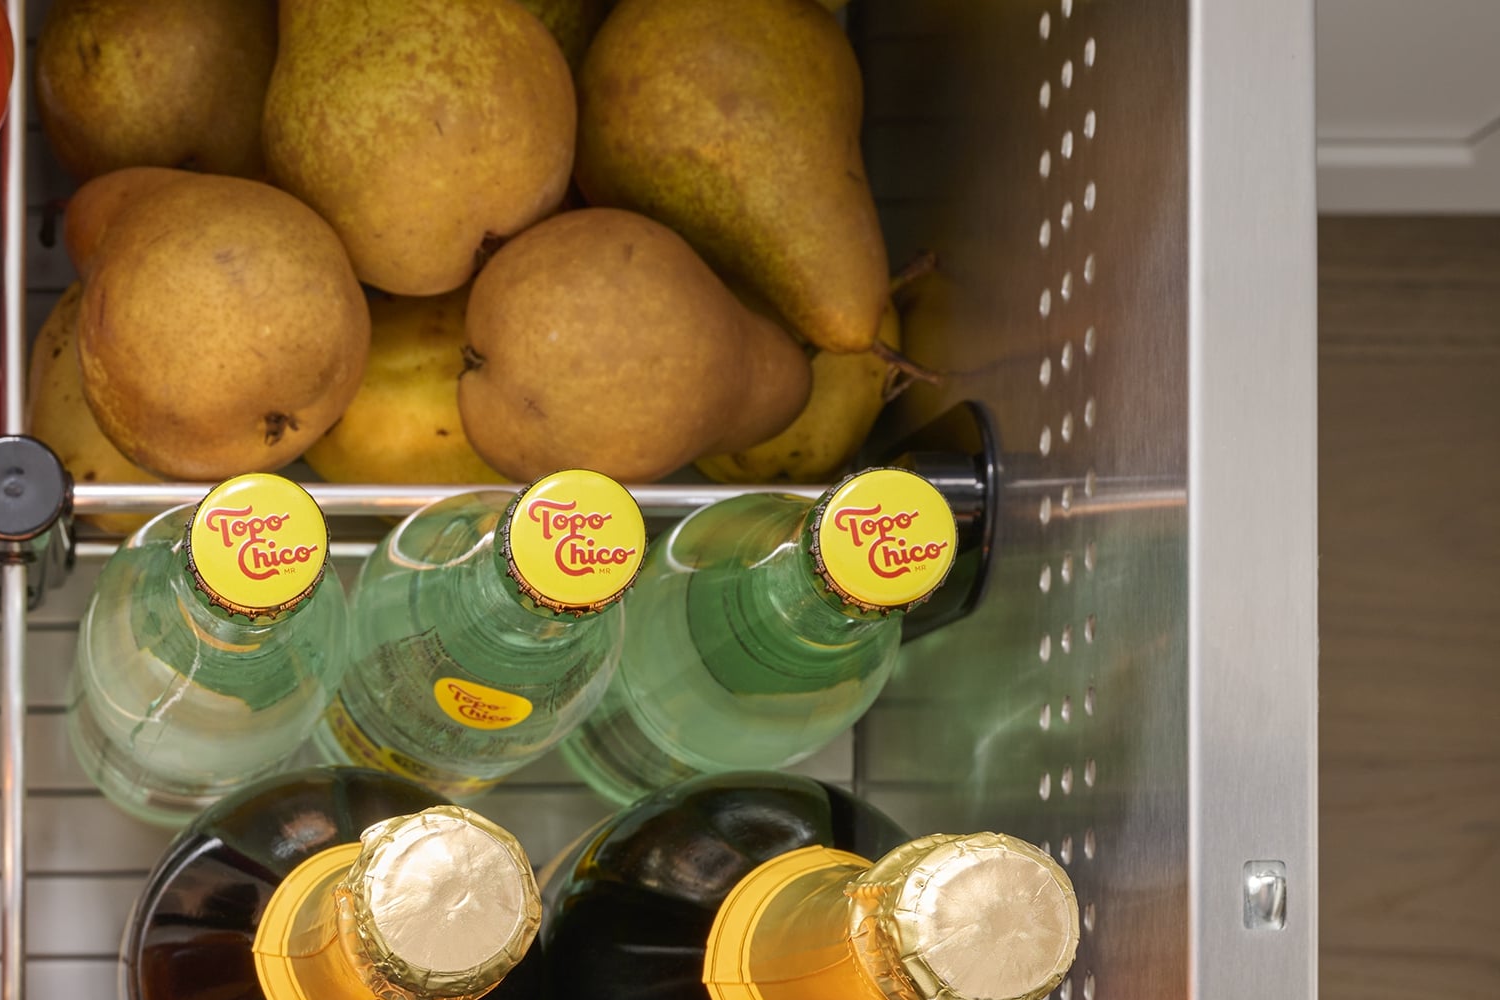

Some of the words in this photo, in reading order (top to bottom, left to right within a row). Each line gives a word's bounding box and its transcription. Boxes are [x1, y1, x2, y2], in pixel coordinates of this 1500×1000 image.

[206, 505, 290, 547] Topo
[528, 500, 612, 540] Topo
[834, 504, 919, 547] Topo
[238, 537, 318, 580] Chico
[283, 567, 297, 575] MR
[555, 534, 636, 577] Chico
[598, 567, 612, 575] MR
[868, 536, 948, 579] Chico
[447, 683, 507, 711] Topo
[458, 704, 519, 723] Chico
